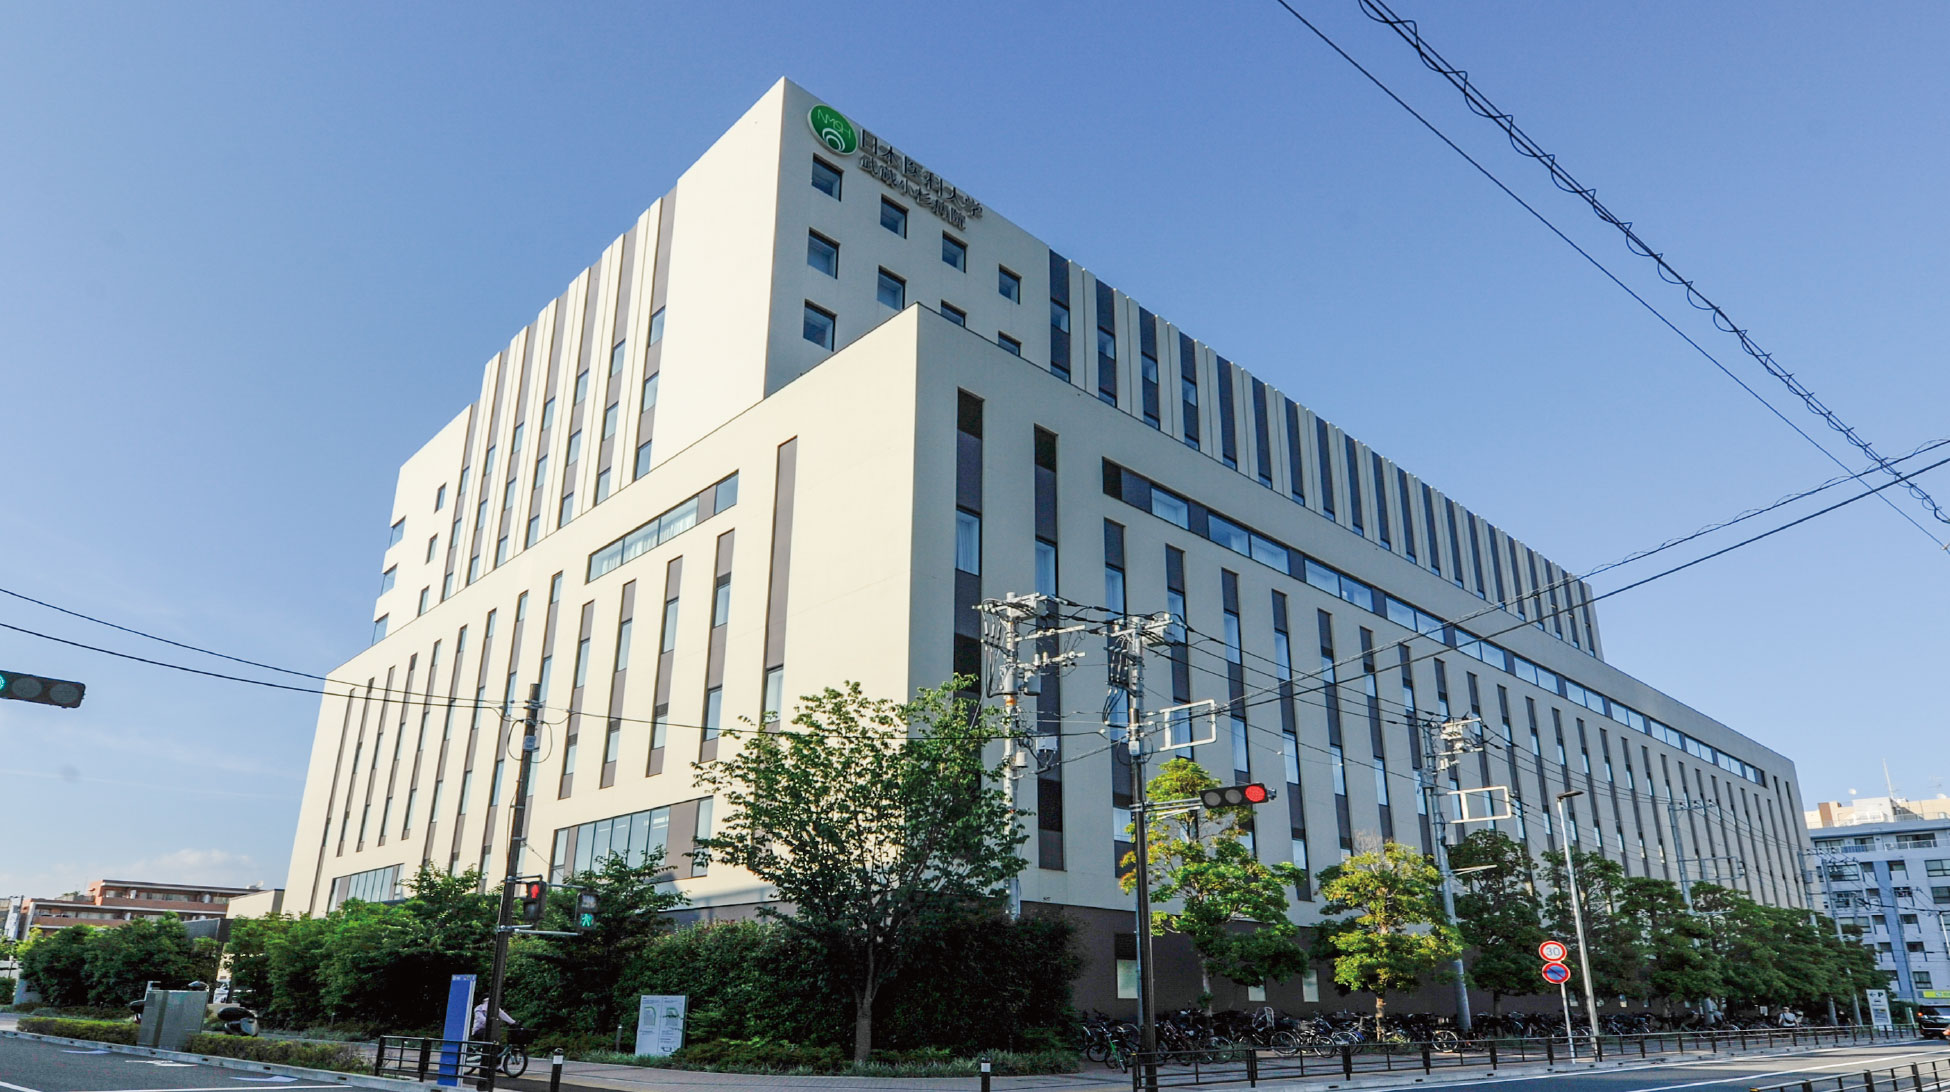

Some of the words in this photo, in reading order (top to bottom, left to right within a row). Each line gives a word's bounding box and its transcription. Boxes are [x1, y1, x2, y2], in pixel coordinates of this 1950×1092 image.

[860, 128, 983, 218] 日本医科大学
[1545, 946, 1561, 957] 30
